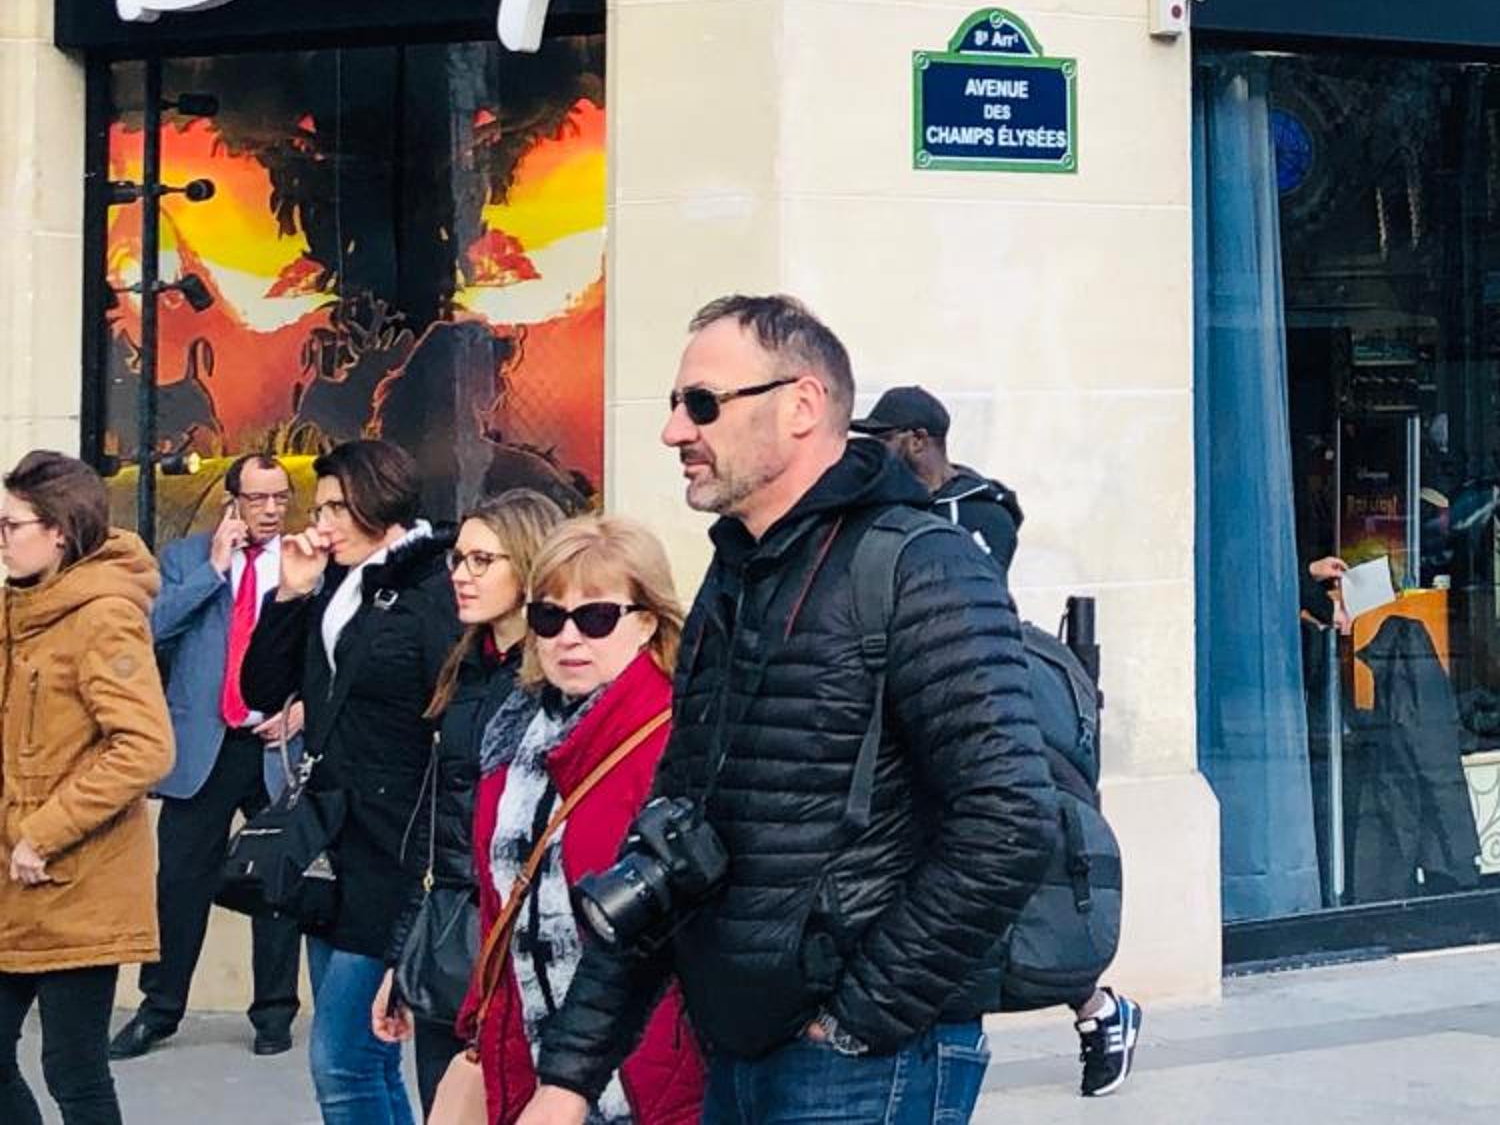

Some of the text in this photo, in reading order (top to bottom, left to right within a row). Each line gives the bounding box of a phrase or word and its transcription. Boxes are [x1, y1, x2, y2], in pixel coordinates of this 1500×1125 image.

[965, 78, 1029, 99] AVENUE
[983, 104, 1011, 120] DES
[926, 125, 1067, 148] CHAMPS ÉLYSÉES
